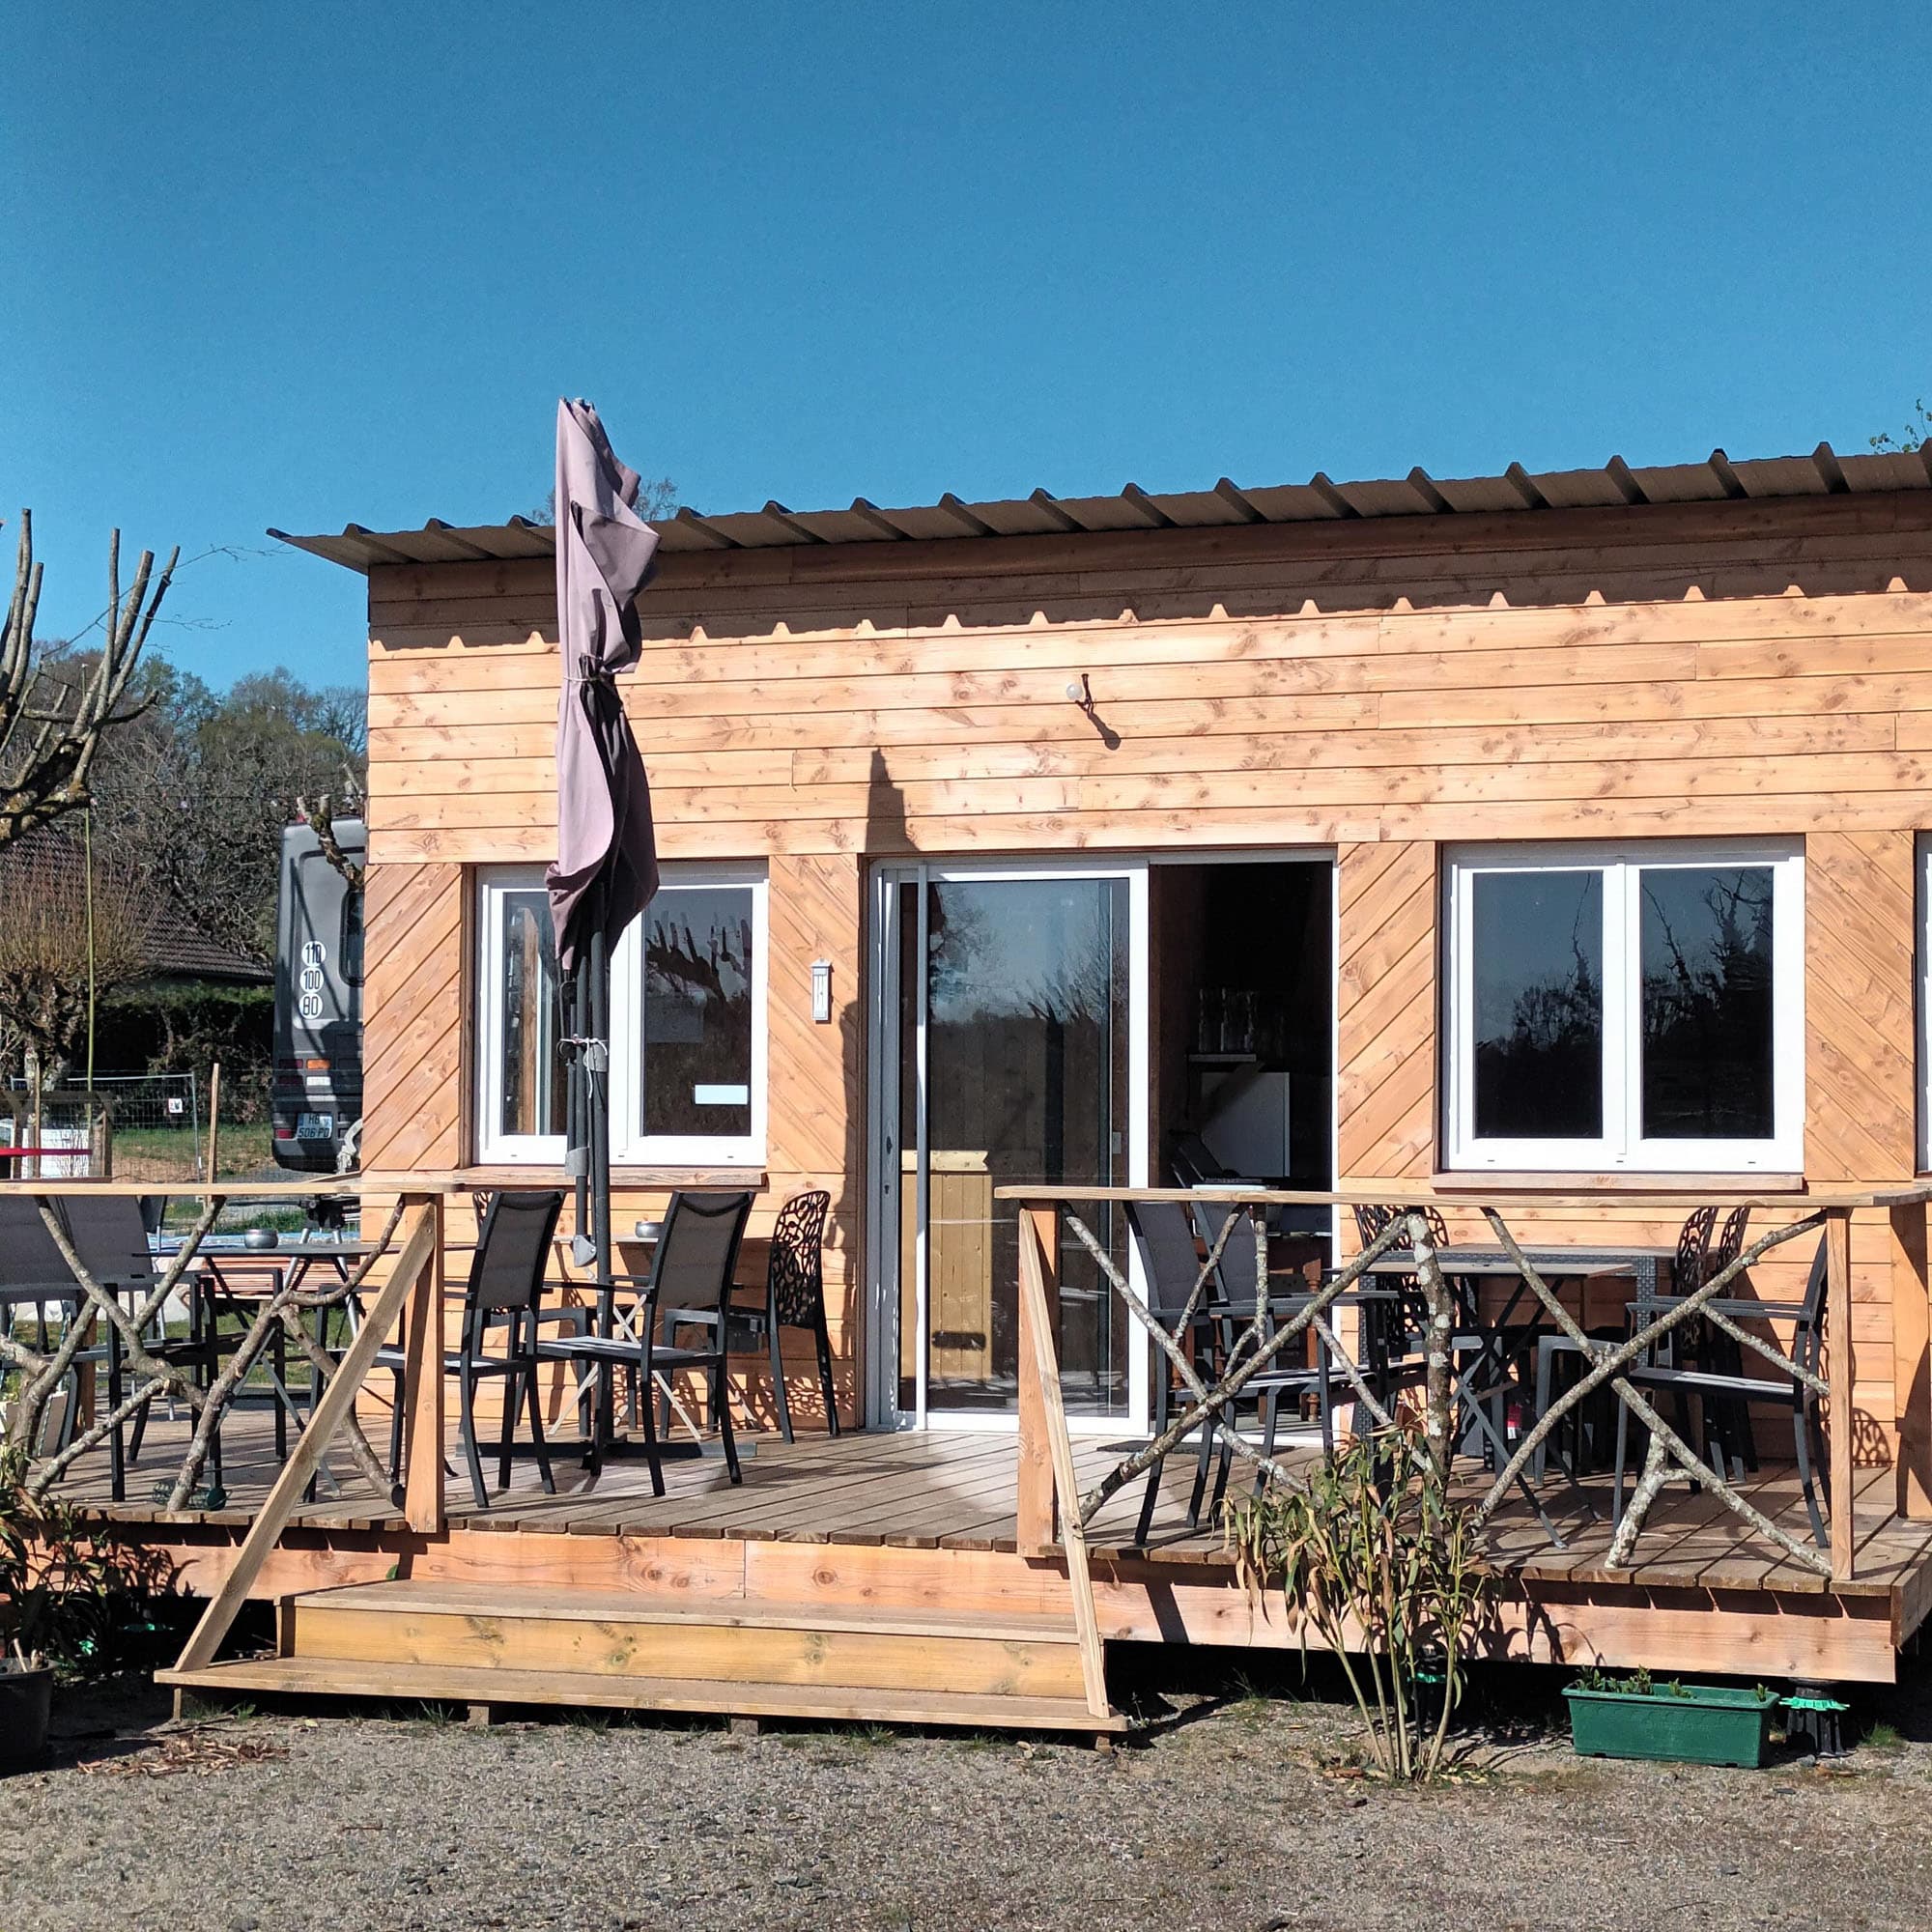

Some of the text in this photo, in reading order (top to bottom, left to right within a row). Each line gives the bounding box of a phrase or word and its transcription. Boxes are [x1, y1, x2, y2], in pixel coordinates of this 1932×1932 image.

[305, 944, 322, 963] 110
[304, 971, 320, 989] 100
[303, 996, 319, 1015] 80
